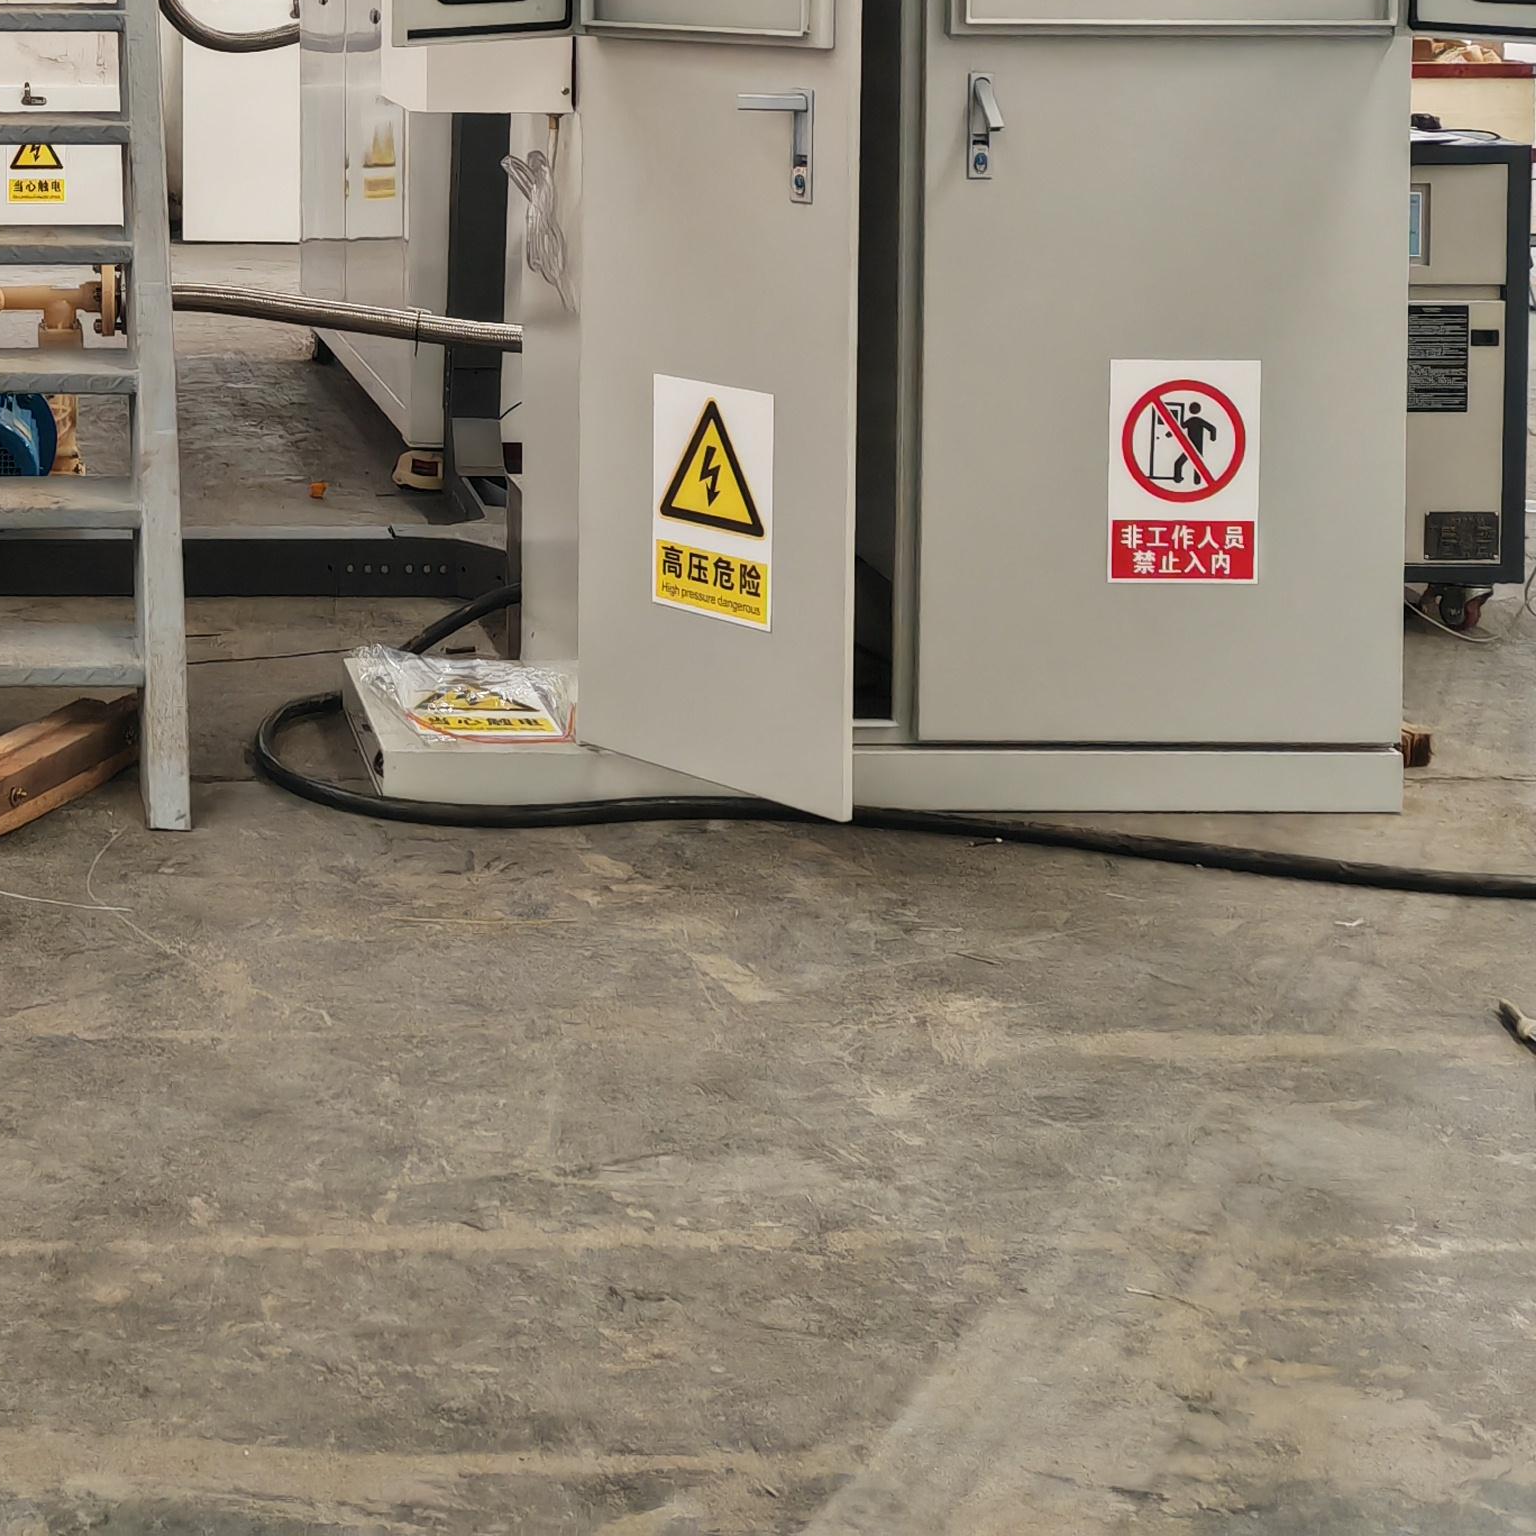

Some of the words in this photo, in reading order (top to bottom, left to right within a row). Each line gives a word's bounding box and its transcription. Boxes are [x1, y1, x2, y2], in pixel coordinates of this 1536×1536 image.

[1120, 524, 1245, 550] 非工作人员
[662, 546, 761, 598] 高压危险
[1132, 550, 1231, 574] 禁止入内
[662, 580, 680, 597] High
[681, 589, 716, 605] pressure
[717, 595, 761, 616] dangerous
